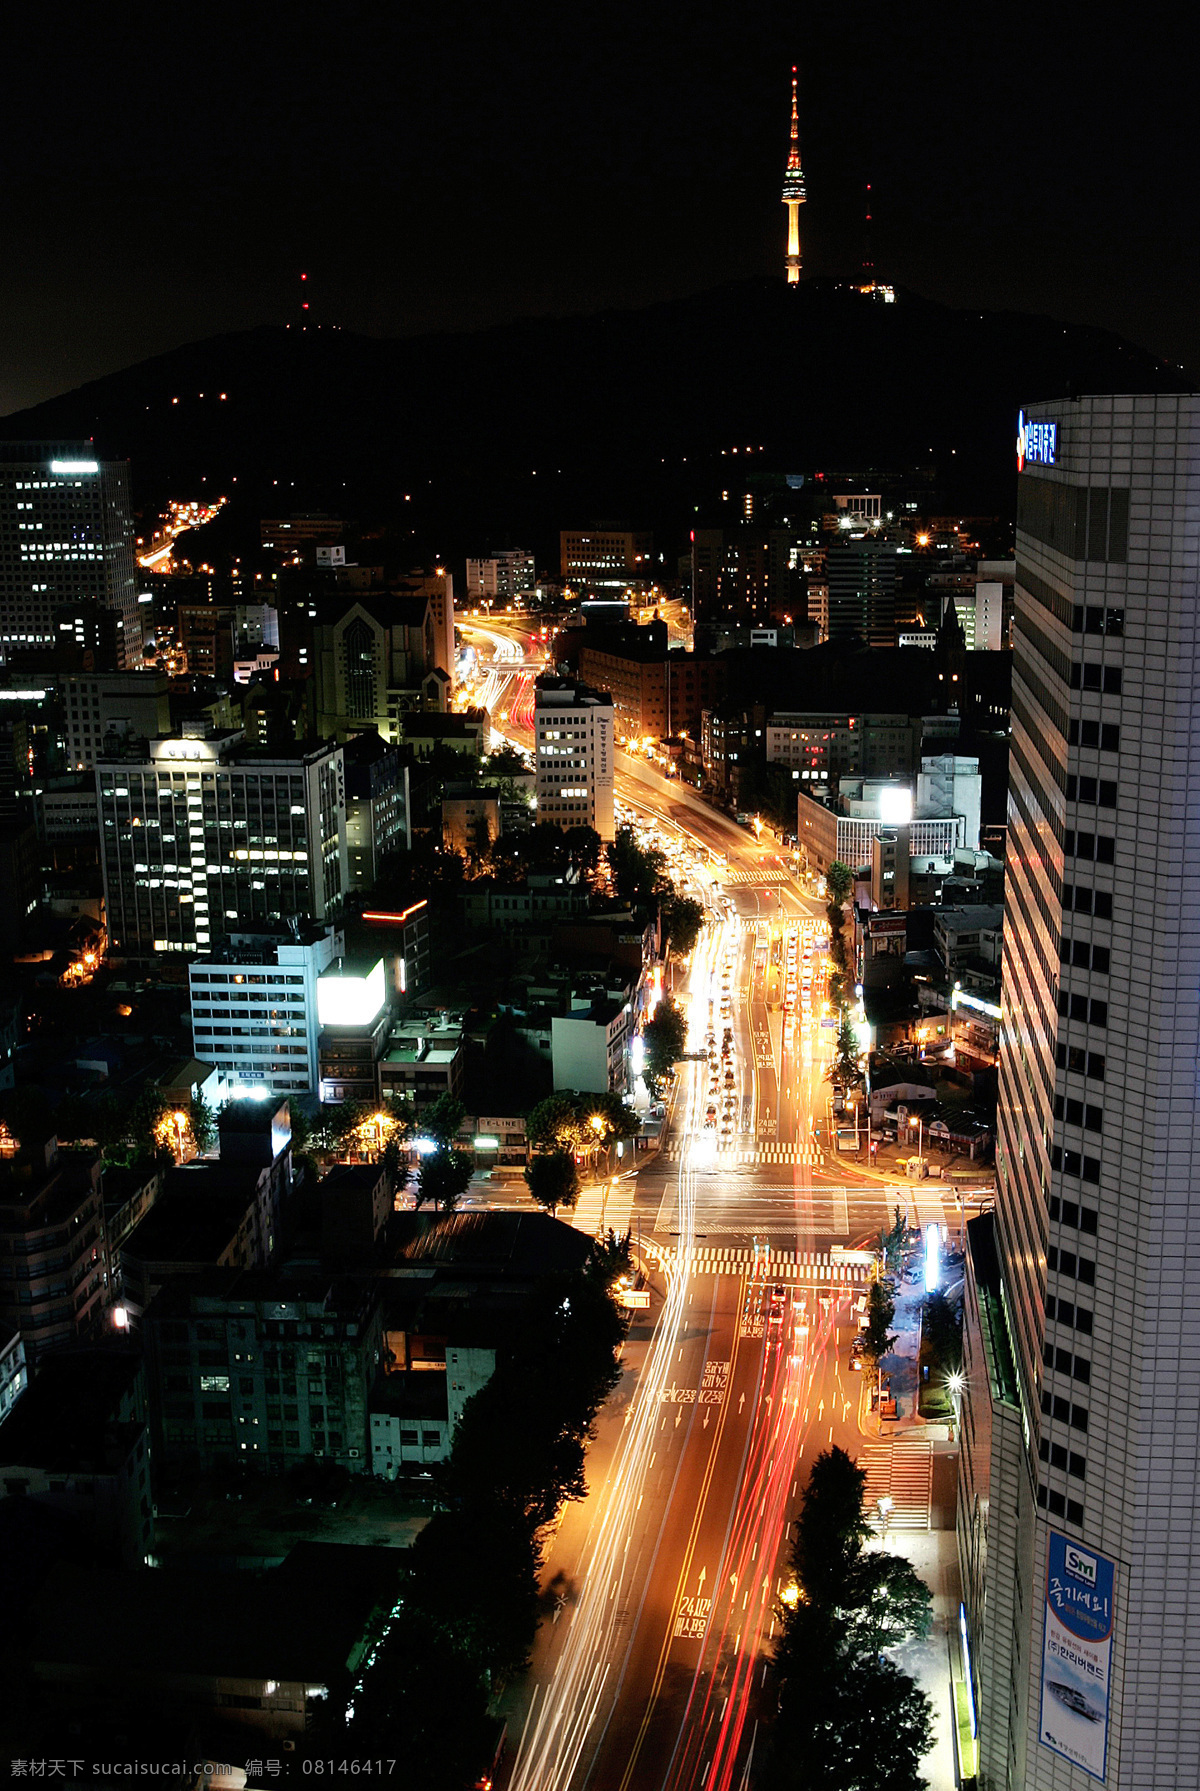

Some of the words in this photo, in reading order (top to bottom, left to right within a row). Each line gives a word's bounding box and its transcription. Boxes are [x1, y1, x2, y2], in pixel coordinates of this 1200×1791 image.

[679, 1597, 711, 1618] 24시간
[1050, 1578, 1108, 1617] 즐기세요!
[674, 1618, 706, 1639] 버스전용
